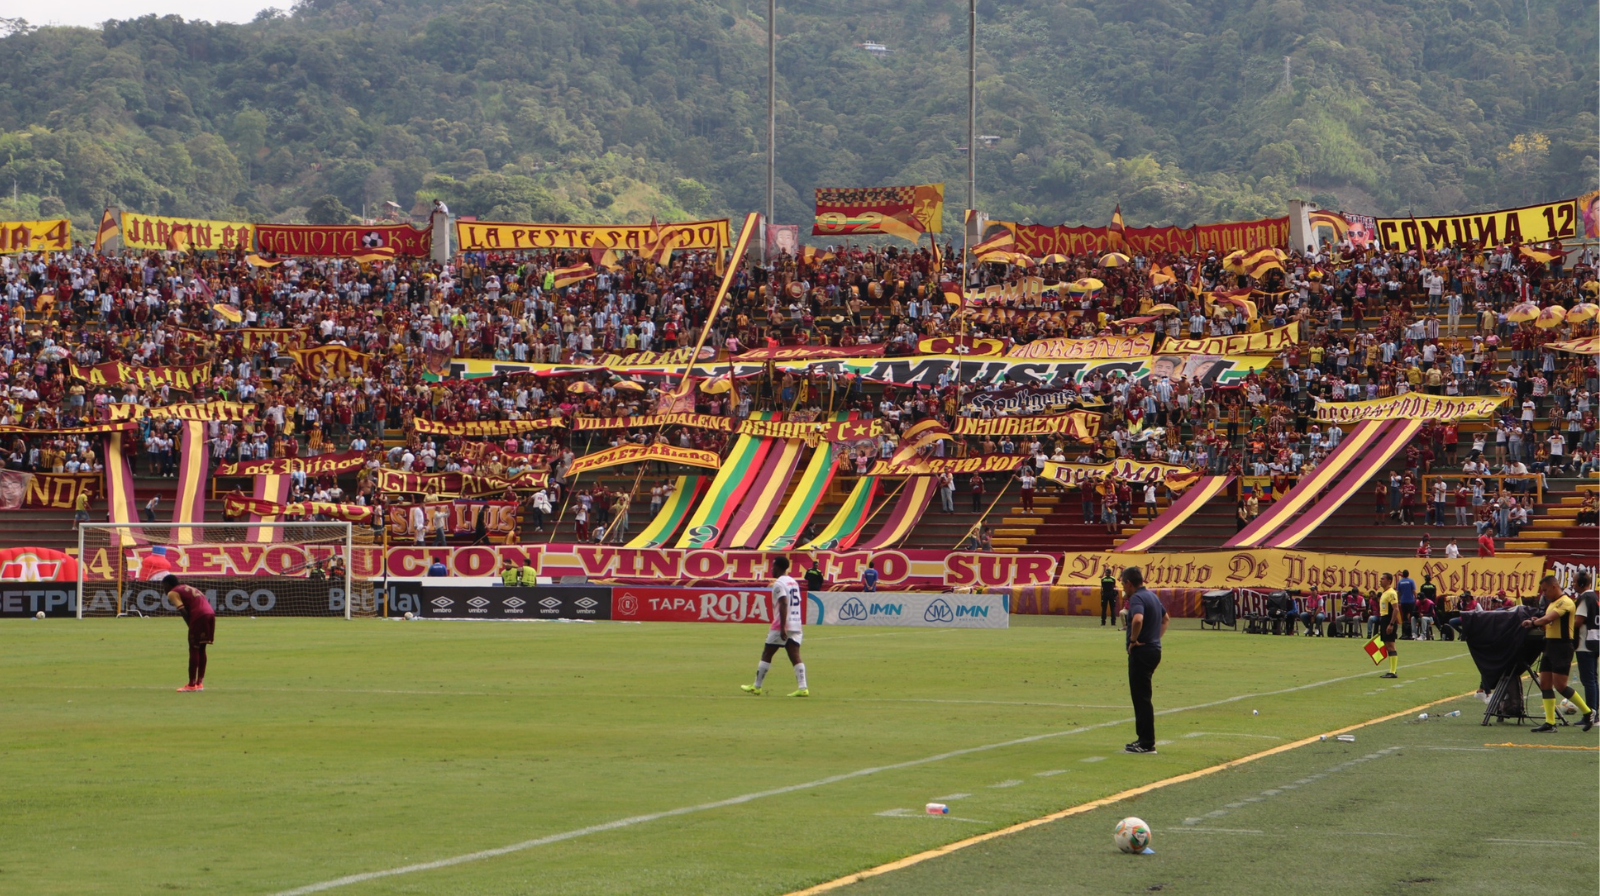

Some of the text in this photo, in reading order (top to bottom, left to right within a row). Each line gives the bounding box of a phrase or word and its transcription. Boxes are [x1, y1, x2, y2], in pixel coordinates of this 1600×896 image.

[468, 227, 715, 250] LA PESTE SALDO
[1381, 204, 1575, 252] COMUNA 12
[258, 230, 357, 255] GAVIOTA
[388, 230, 403, 251] K
[918, 337, 955, 354] C
[1162, 327, 1293, 355] MODELIA
[71, 364, 107, 387] LA
[862, 357, 1243, 390] MUSICL
[576, 415, 732, 431] VILLA MAGDALENA
[837, 421, 852, 441] C
[952, 412, 1102, 436] INSURGENTS
[221, 461, 275, 476] Los
[928, 457, 984, 475] REVO
[981, 456, 1025, 472] SOY
[574, 547, 912, 586] VINOTINTO
[944, 552, 1059, 588] SUR
[1068, 554, 1214, 585] Vintinto
[1225, 552, 1271, 585] De
[1281, 554, 1380, 594] Pasión
[0, 589, 276, 612] ETPLAY.C.CO
[329, 586, 421, 617] BetPlay
[648, 591, 771, 622] TAPA ROJA
[789, 588, 801, 607] 15
[869, 603, 903, 615] IMN
[955, 604, 990, 617] IMN
